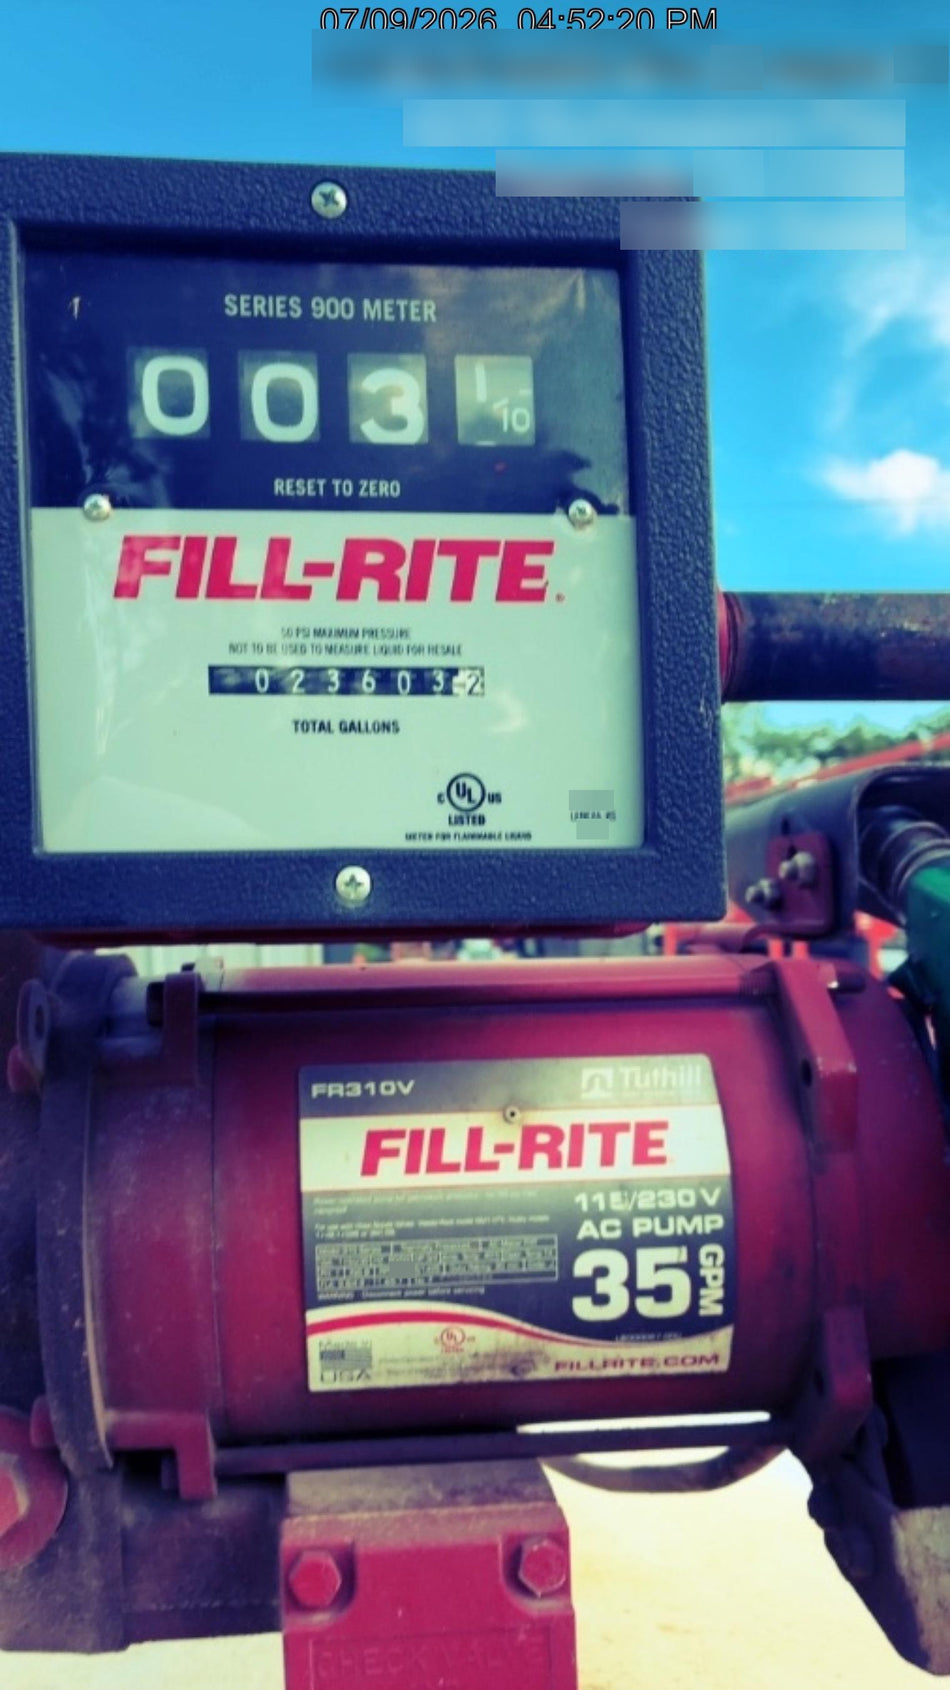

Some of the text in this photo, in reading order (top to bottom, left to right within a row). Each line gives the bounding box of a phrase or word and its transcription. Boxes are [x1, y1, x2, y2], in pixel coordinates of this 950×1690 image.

[225, 294, 436, 323] SERIES 900 METER
[274, 478, 401, 498] RESET TO ZERO
[113, 535, 555, 602] FILL-RITE
[313, 627, 360, 639] MAXIMUM
[362, 627, 411, 640] PRESSURE
[228, 643, 248, 655] NOT
[252, 643, 264, 655] TO
[310, 643, 322, 656] TO
[324, 643, 371, 656] MEASURE
[406, 643, 425, 656] FOR
[427, 643, 463, 656] RESALE
[293, 720, 400, 735] TOTAL GALLONS
[448, 814, 486, 827] LISTED
[619, 1065, 702, 1090] Tuthill
[311, 1080, 415, 1098] FR310V
[360, 1120, 669, 1177] FILL-RITE
[576, 1218, 623, 1240] AC
[632, 1214, 724, 1238] PUMP
[572, 1246, 692, 1321] 35
[698, 1243, 725, 1317] GPM
[554, 1353, 720, 1372] FILLRITE.COM
